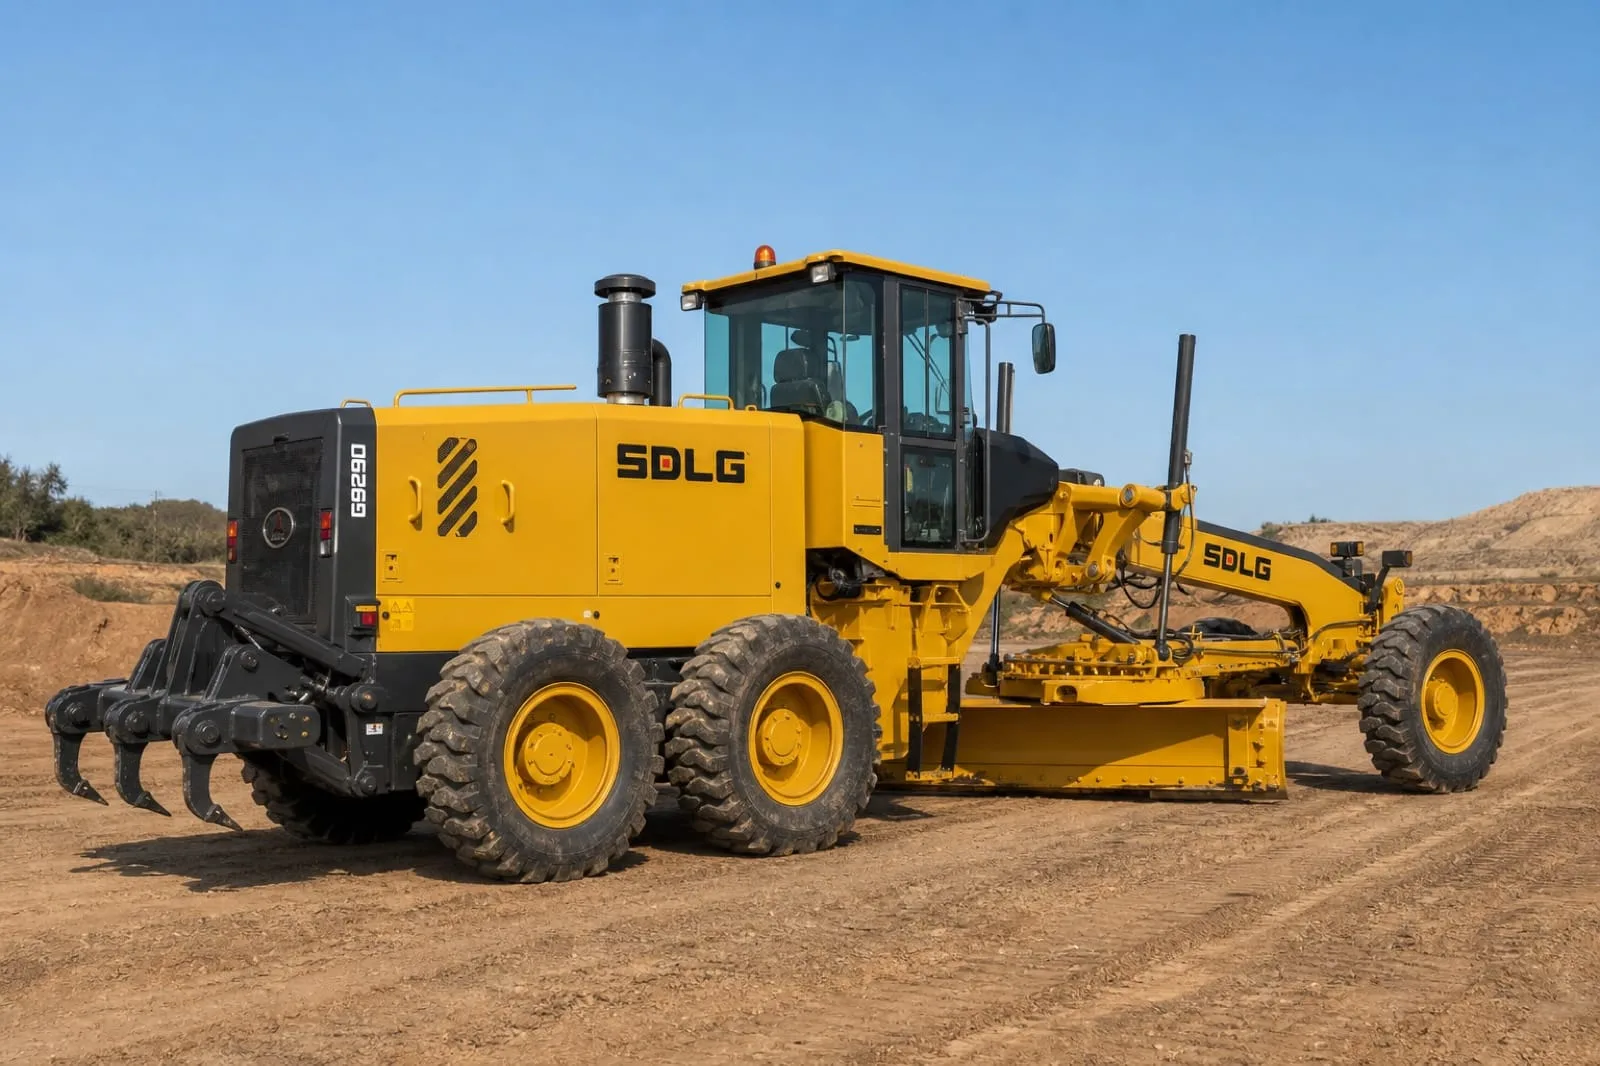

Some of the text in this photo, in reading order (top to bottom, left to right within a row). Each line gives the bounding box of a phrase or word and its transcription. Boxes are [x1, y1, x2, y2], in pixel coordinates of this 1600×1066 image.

[351, 444, 366, 517] G9290
[617, 443, 745, 483] SDLG
[1204, 543, 1271, 581] SDLG
